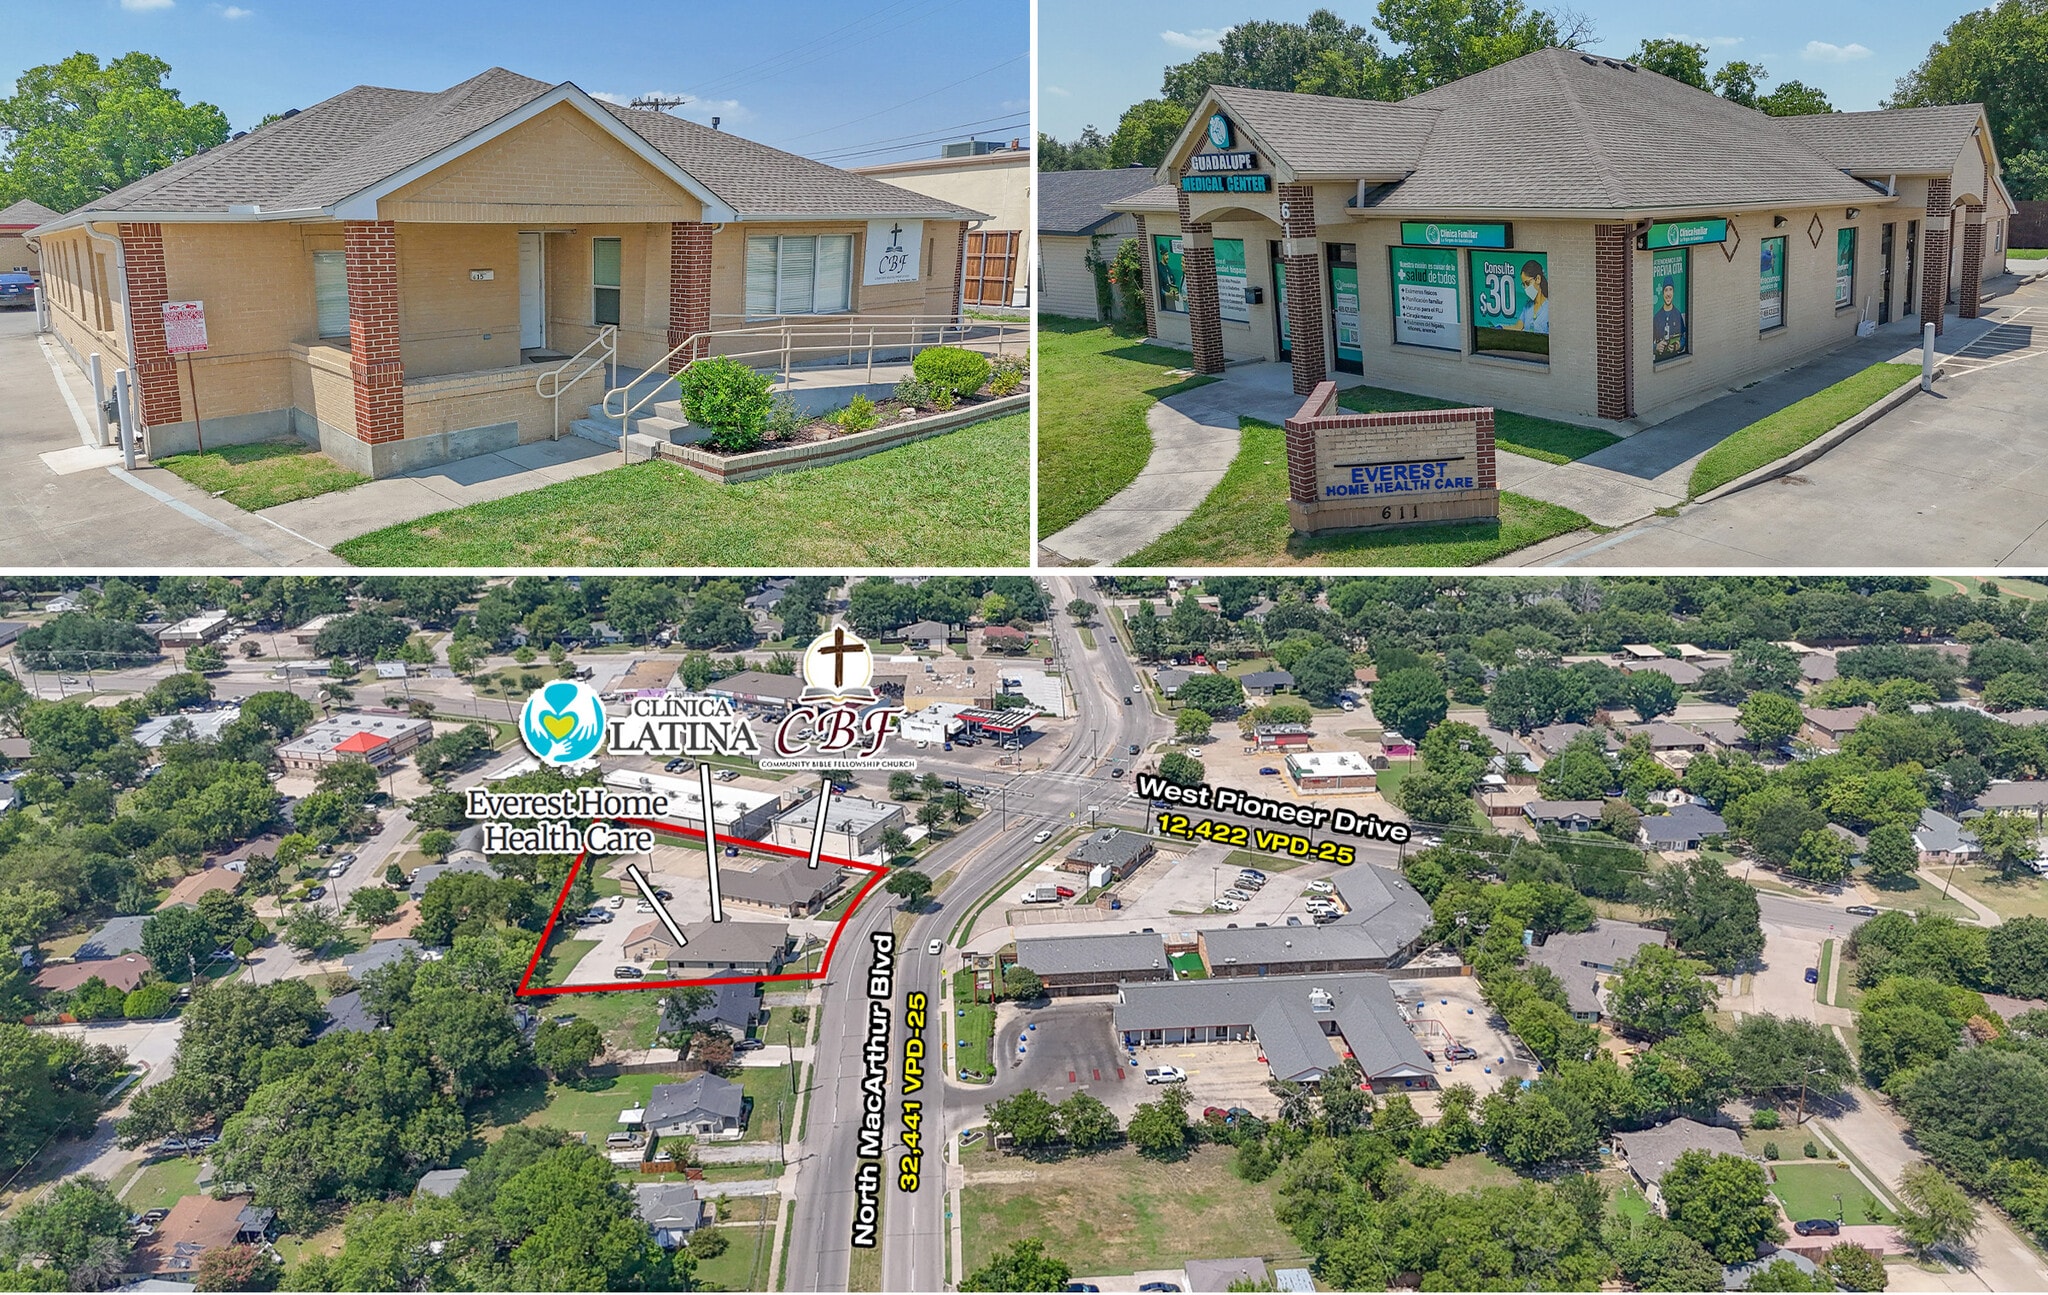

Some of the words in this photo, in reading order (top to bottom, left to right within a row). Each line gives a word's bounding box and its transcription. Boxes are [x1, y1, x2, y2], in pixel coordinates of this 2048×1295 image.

[1191, 154, 1251, 171] GUADALUPE
[1182, 175, 1224, 192] MEDICAL
[1226, 175, 1267, 192] CENTER
[1458, 230, 1478, 239] Familiar
[878, 254, 909, 274] CBF
[1484, 261, 1515, 275] Consulta
[1653, 265, 1672, 277] PREVIA
[1406, 268, 1427, 282] salud
[1428, 270, 1436, 283] de
[1437, 271, 1456, 285] todos
[1351, 462, 1448, 484] EVEREST
[1326, 483, 1370, 497] HOME
[1374, 479, 1431, 494] HEALTH
[1434, 477, 1473, 490] CARE
[1381, 505, 1419, 520] 611
